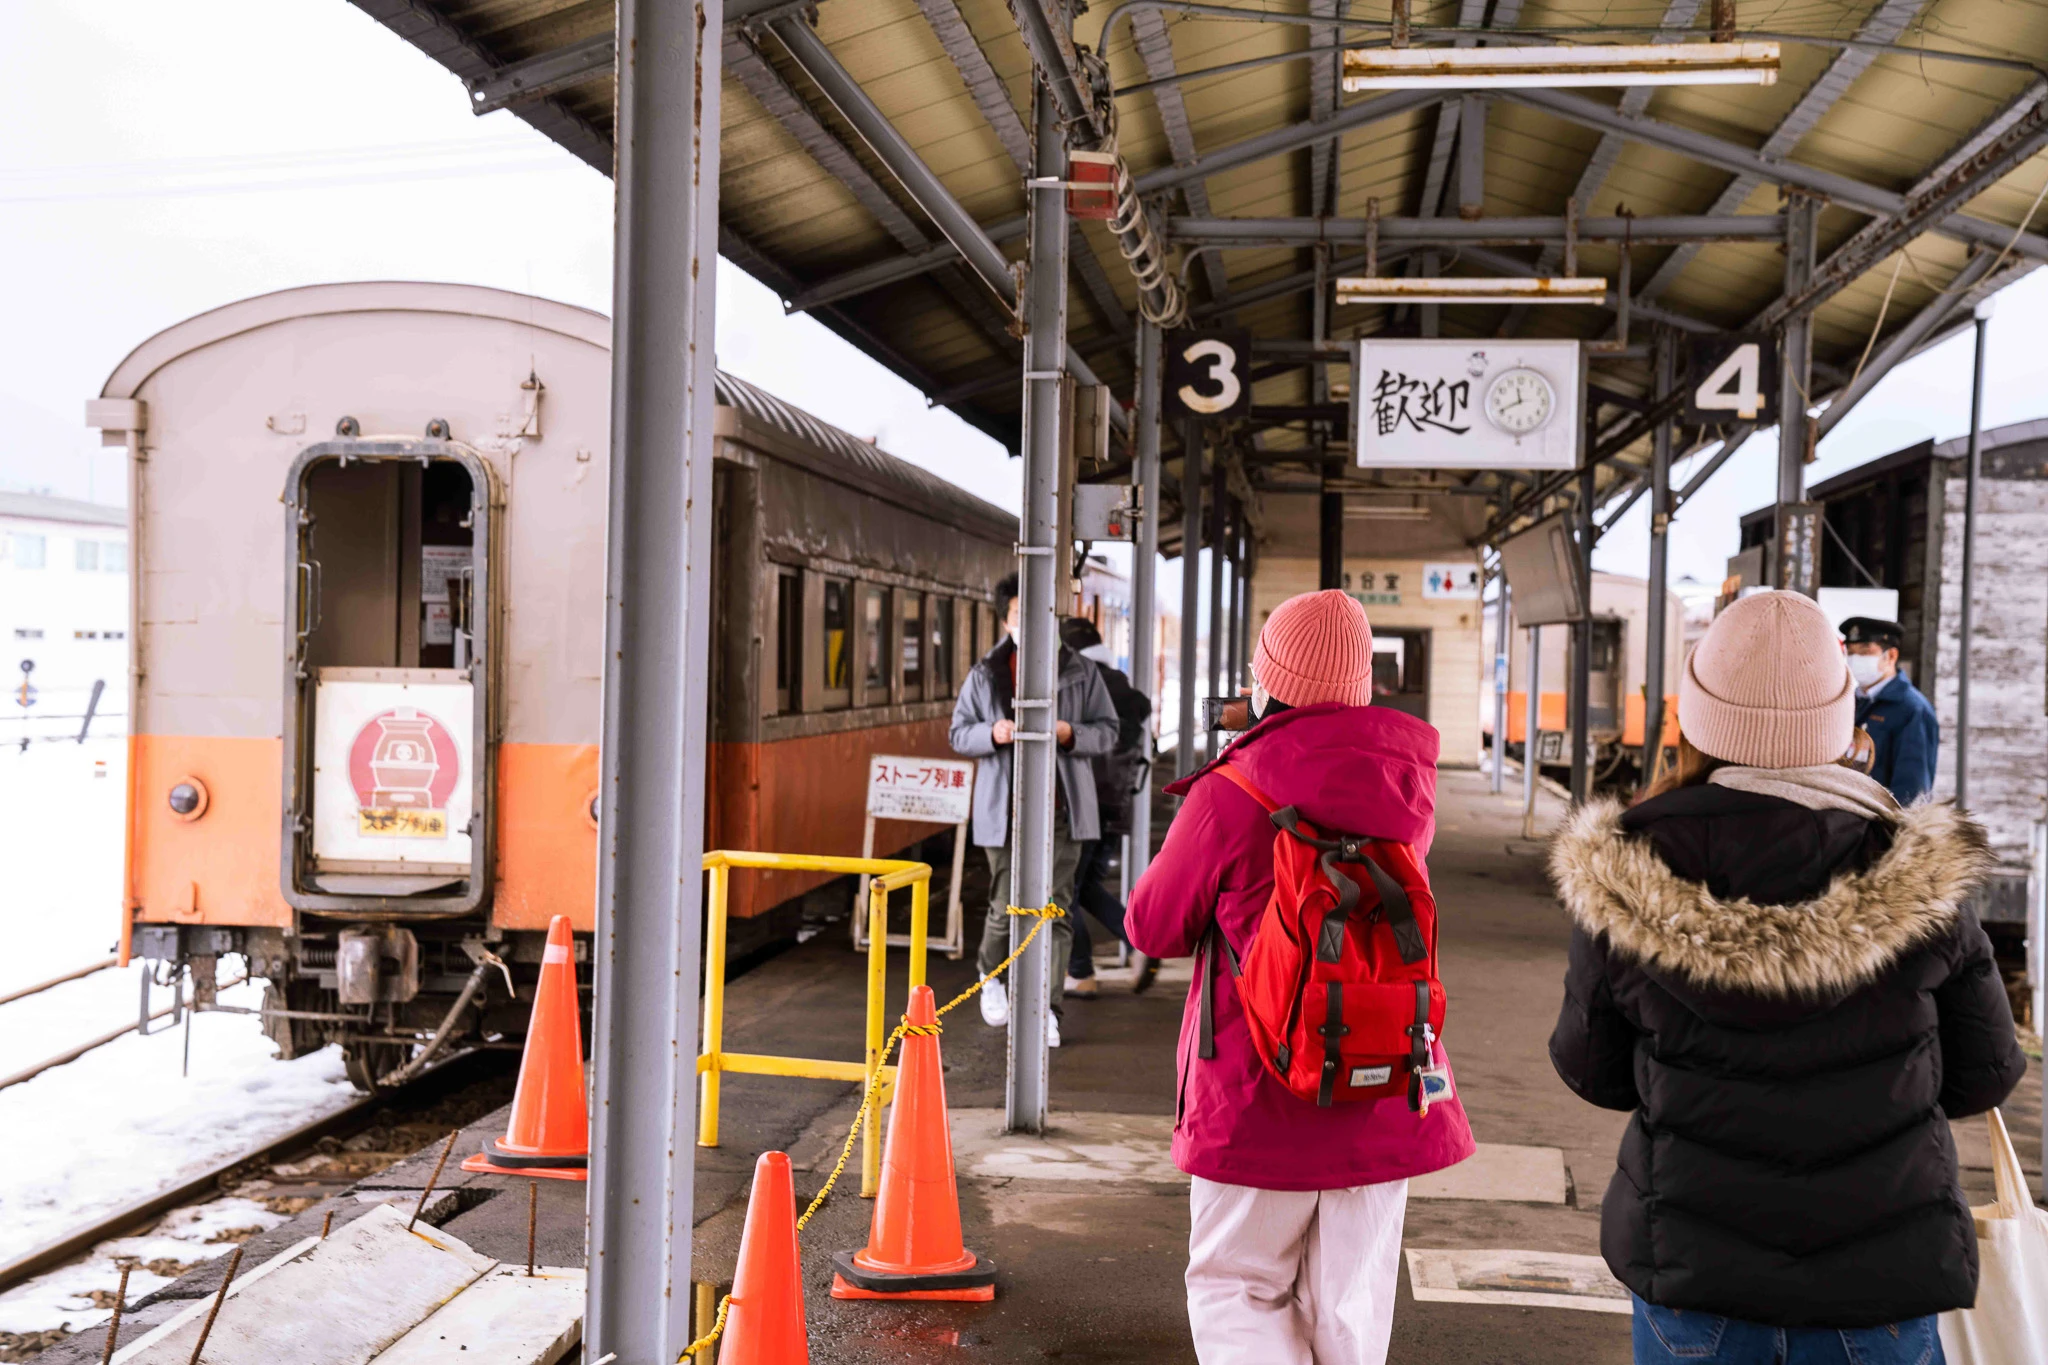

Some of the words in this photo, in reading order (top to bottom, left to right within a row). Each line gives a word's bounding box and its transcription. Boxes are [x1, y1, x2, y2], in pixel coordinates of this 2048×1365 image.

[1178, 339, 1241, 413] 3
[1371, 368, 1471, 435] 歓迎
[1695, 343, 1765, 419] 4
